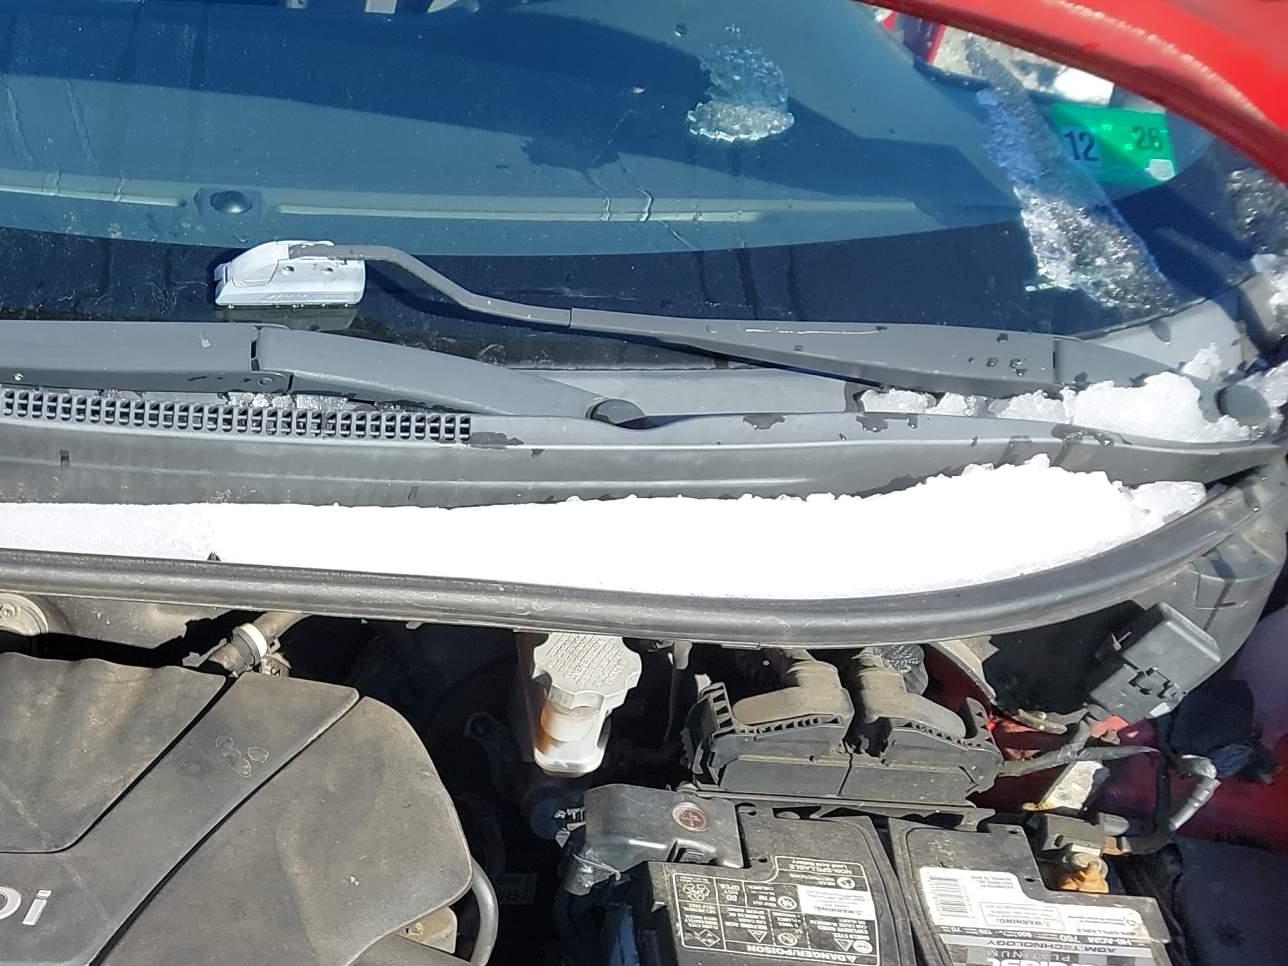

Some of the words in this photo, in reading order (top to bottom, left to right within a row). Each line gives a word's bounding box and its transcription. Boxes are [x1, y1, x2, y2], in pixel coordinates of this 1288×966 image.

[1063, 130, 1100, 161] 12
[987, 939, 1079, 952] TECHNOLOGY
[1084, 945, 1117, 954] AGM
[745, 944, 848, 963] DANGER/POISON
[987, 949, 1072, 963] PLATINUM
